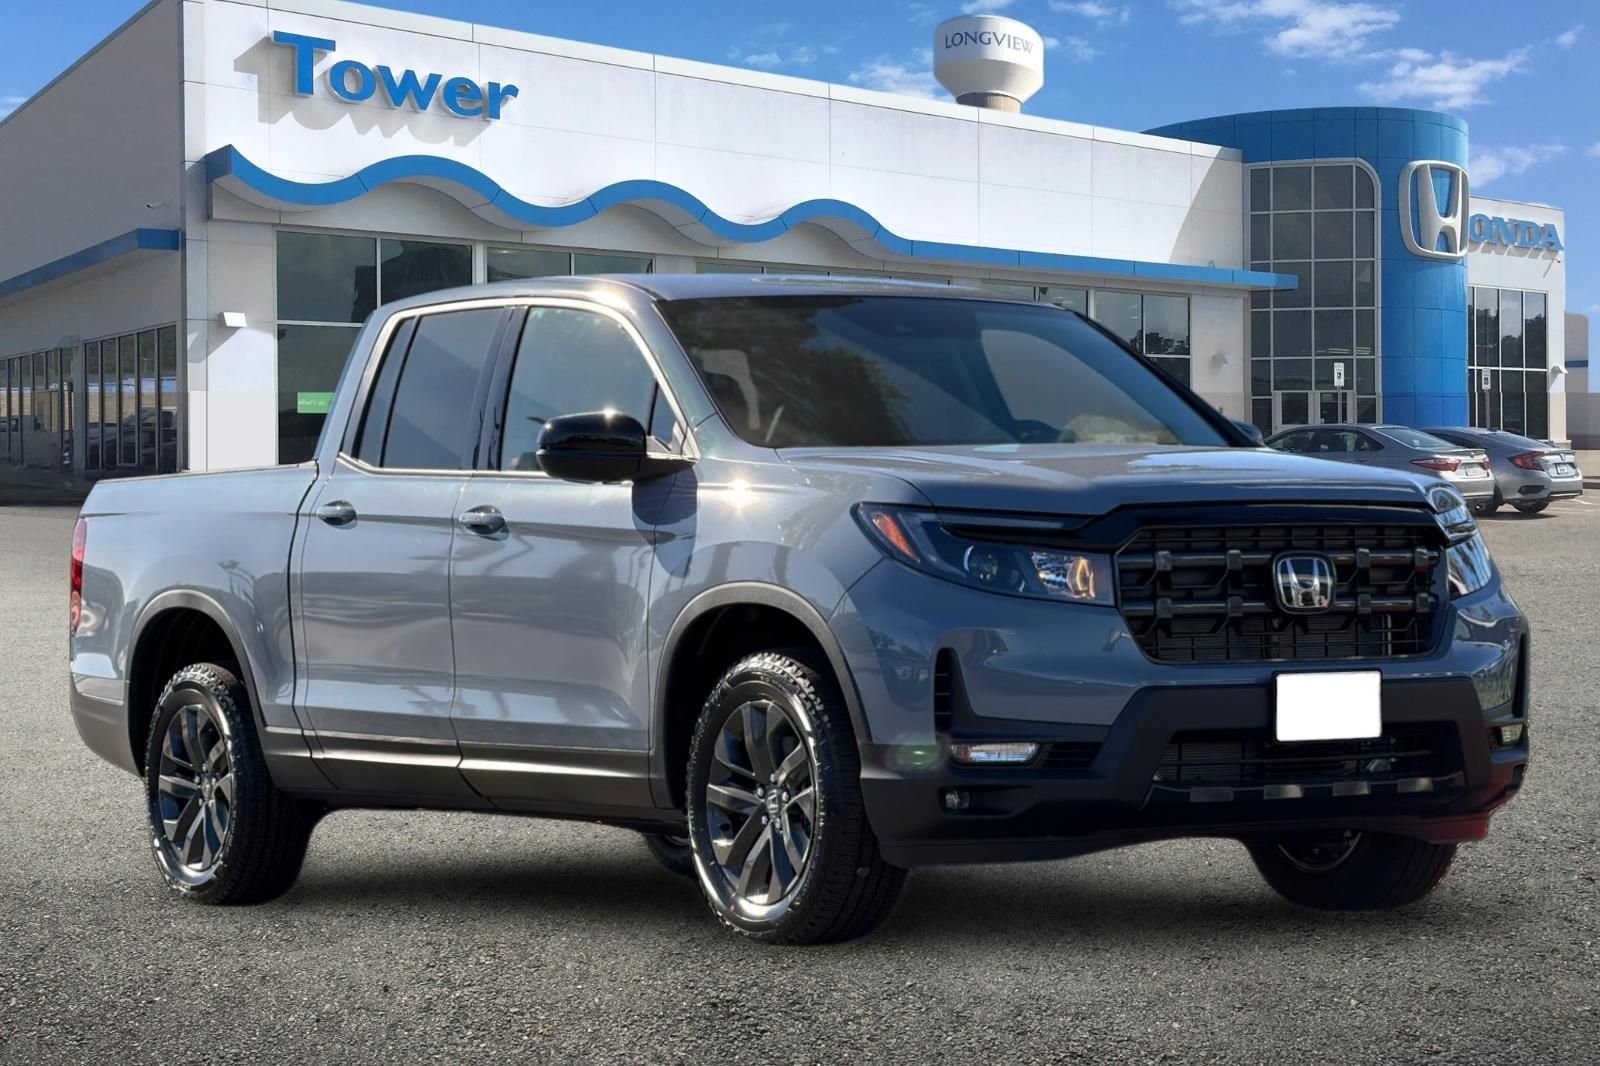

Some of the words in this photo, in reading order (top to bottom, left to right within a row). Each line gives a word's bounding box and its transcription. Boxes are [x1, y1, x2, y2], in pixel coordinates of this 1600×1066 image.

[945, 31, 1034, 55] LONGVIEW
[273, 30, 519, 120] Tower
[1469, 213, 1564, 251] ONDA
